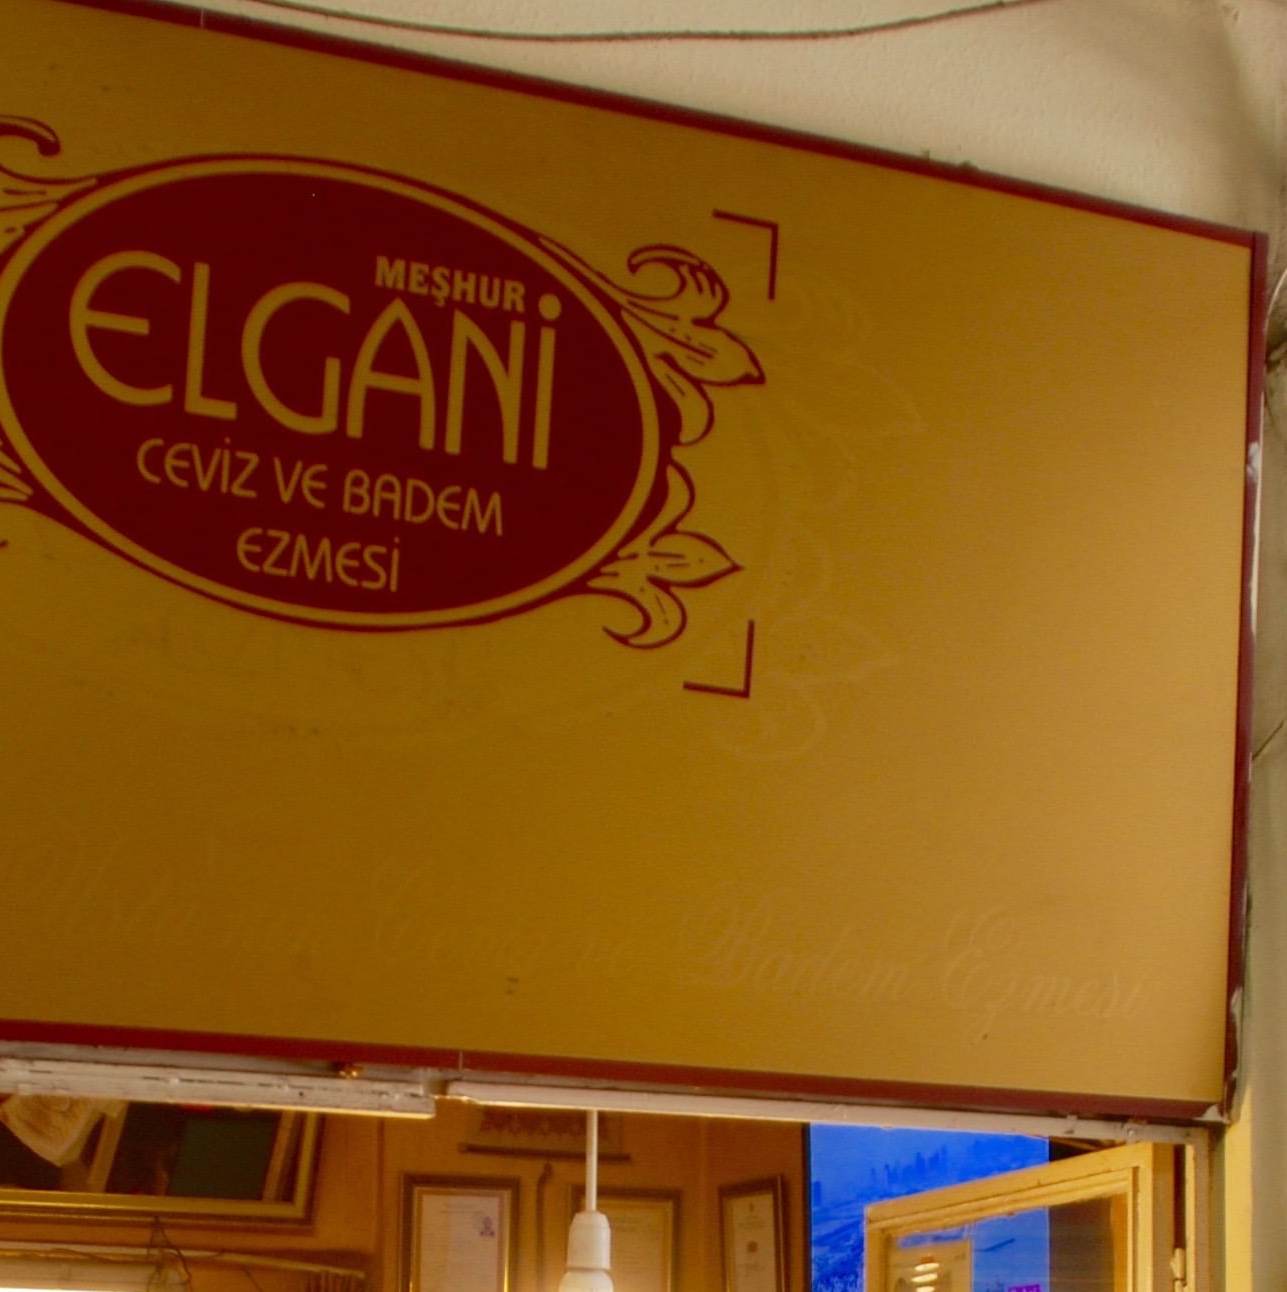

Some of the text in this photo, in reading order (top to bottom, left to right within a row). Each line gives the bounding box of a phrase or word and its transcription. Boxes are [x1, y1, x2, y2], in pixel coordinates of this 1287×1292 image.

[373, 255, 526, 312] MEŞHUR
[68, 249, 563, 470] ELGANİ
[136, 436, 504, 537] CEVİZ VE BADEM
[236, 527, 401, 594] EZMESİ
